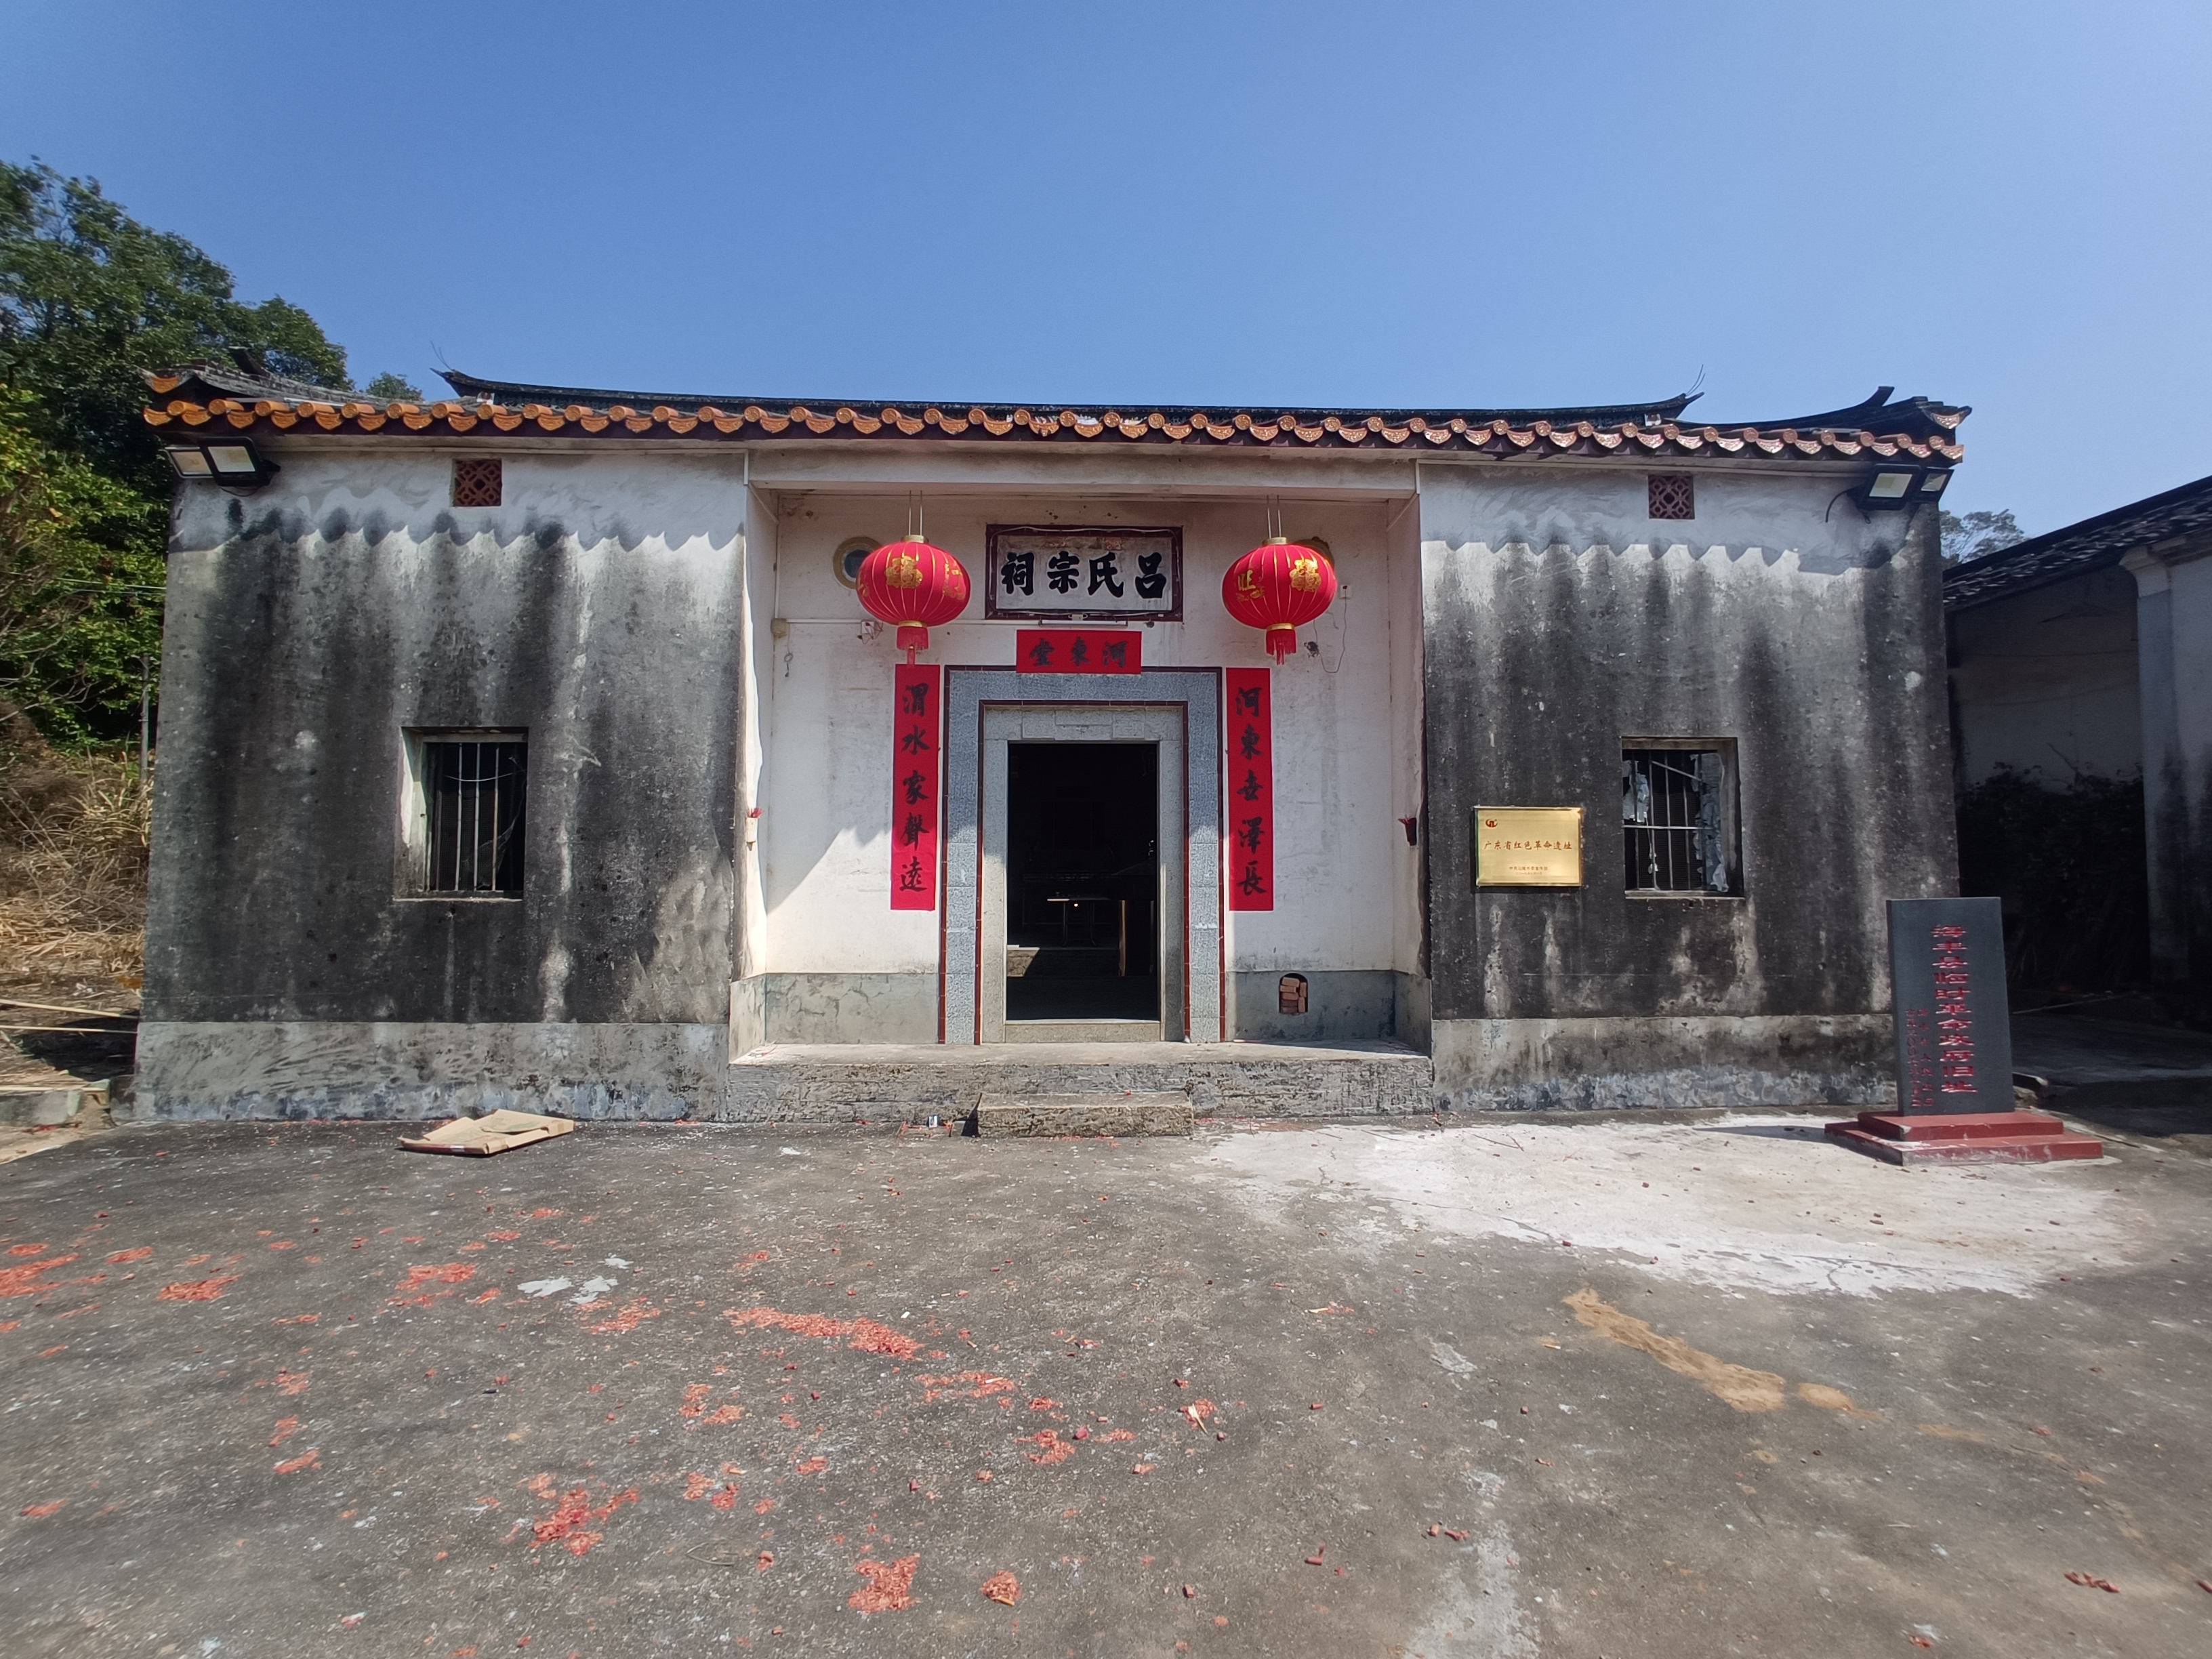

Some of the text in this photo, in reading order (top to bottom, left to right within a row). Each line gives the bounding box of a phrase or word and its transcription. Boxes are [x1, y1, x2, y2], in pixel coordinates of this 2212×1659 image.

[899, 682, 930, 892] 渭水家聲遠
[1483, 840, 1572, 851] 广东省红色革命遗址
[1931, 925, 1978, 1093] 海丰县临时革命政府旧址
